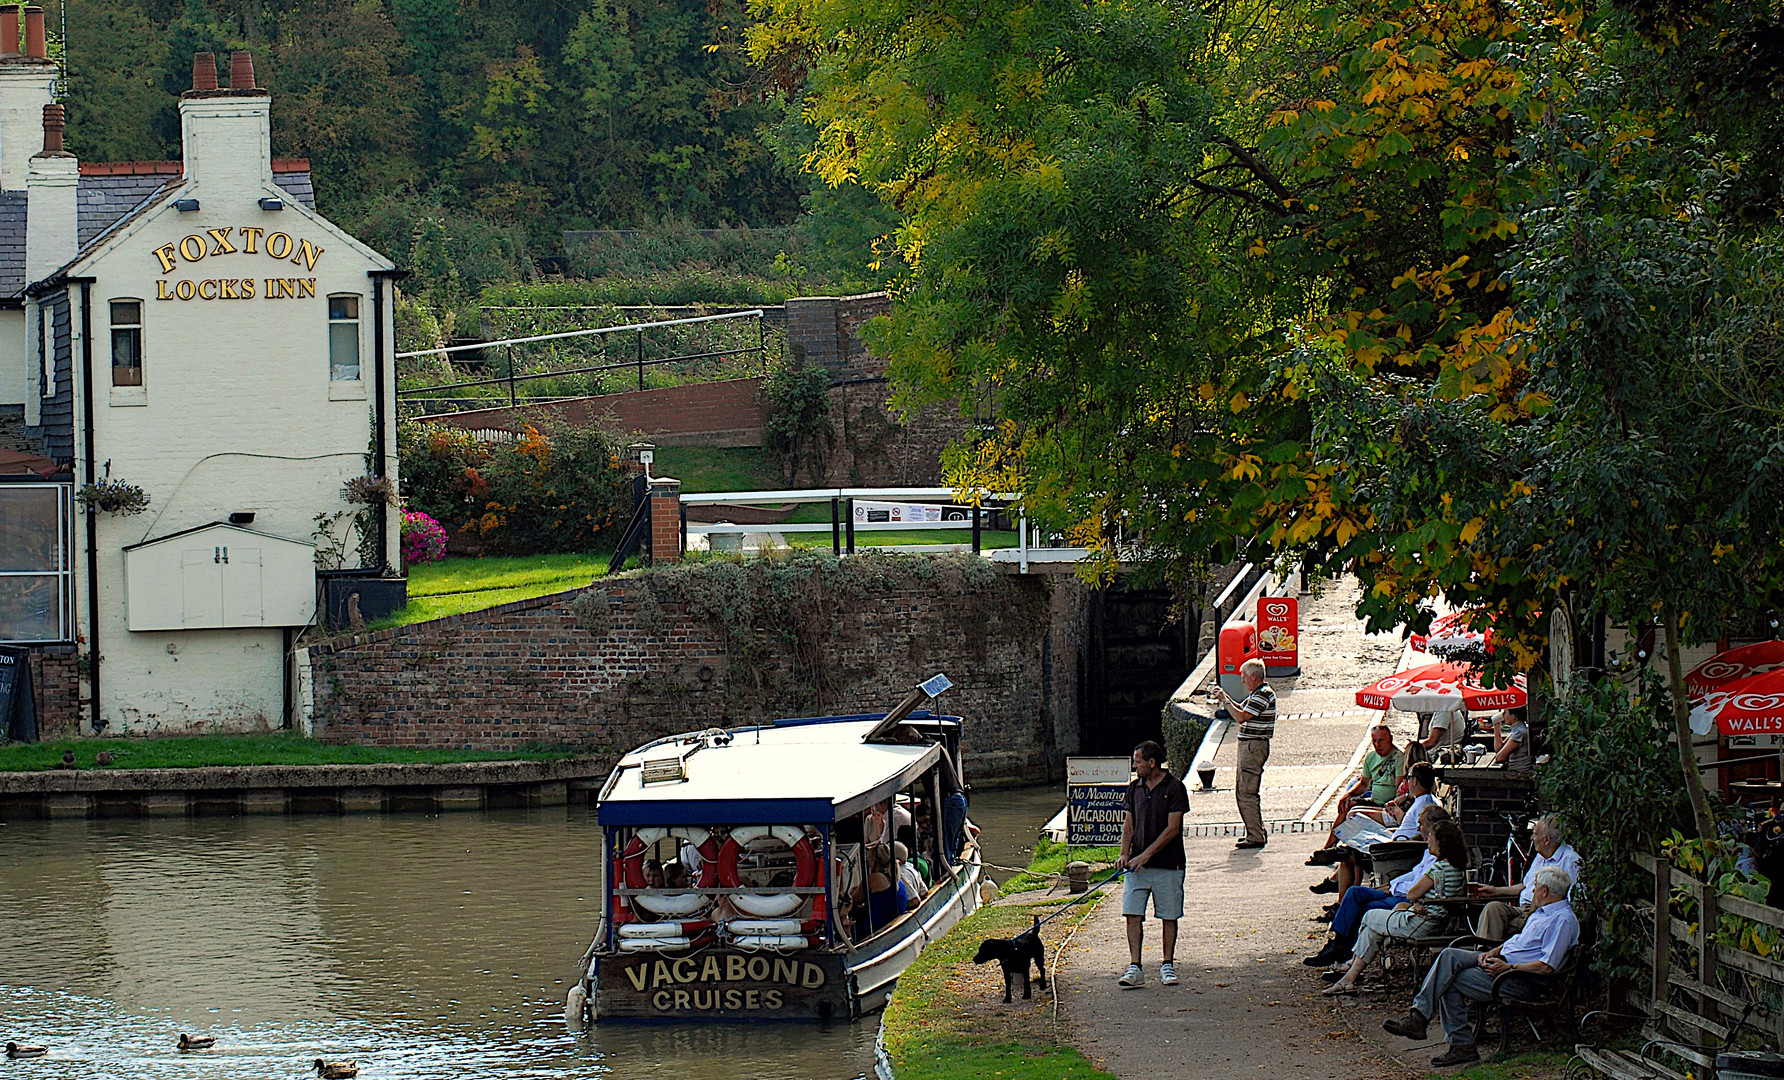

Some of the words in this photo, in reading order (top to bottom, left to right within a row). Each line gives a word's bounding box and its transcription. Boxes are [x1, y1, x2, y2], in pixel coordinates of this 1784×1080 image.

[152, 226, 325, 275] FOXTON
[156, 278, 256, 301] LOCKS
[264, 277, 317, 299] INN
[1363, 694, 1385, 706] WALL'S
[1476, 694, 1516, 707] WALL'S
[1728, 716, 1782, 731] WALL'S
[1070, 787, 1085, 800] No
[1085, 787, 1126, 802] Mooring
[1087, 800, 1115, 808] please
[1070, 805, 1127, 823] VAGABOND
[1070, 823, 1095, 833] TRIP
[1100, 823, 1124, 833] BOAT
[1071, 833, 1123, 843] Operating
[624, 955, 825, 992] VAGABOND
[652, 989, 784, 1011] CRUISES
